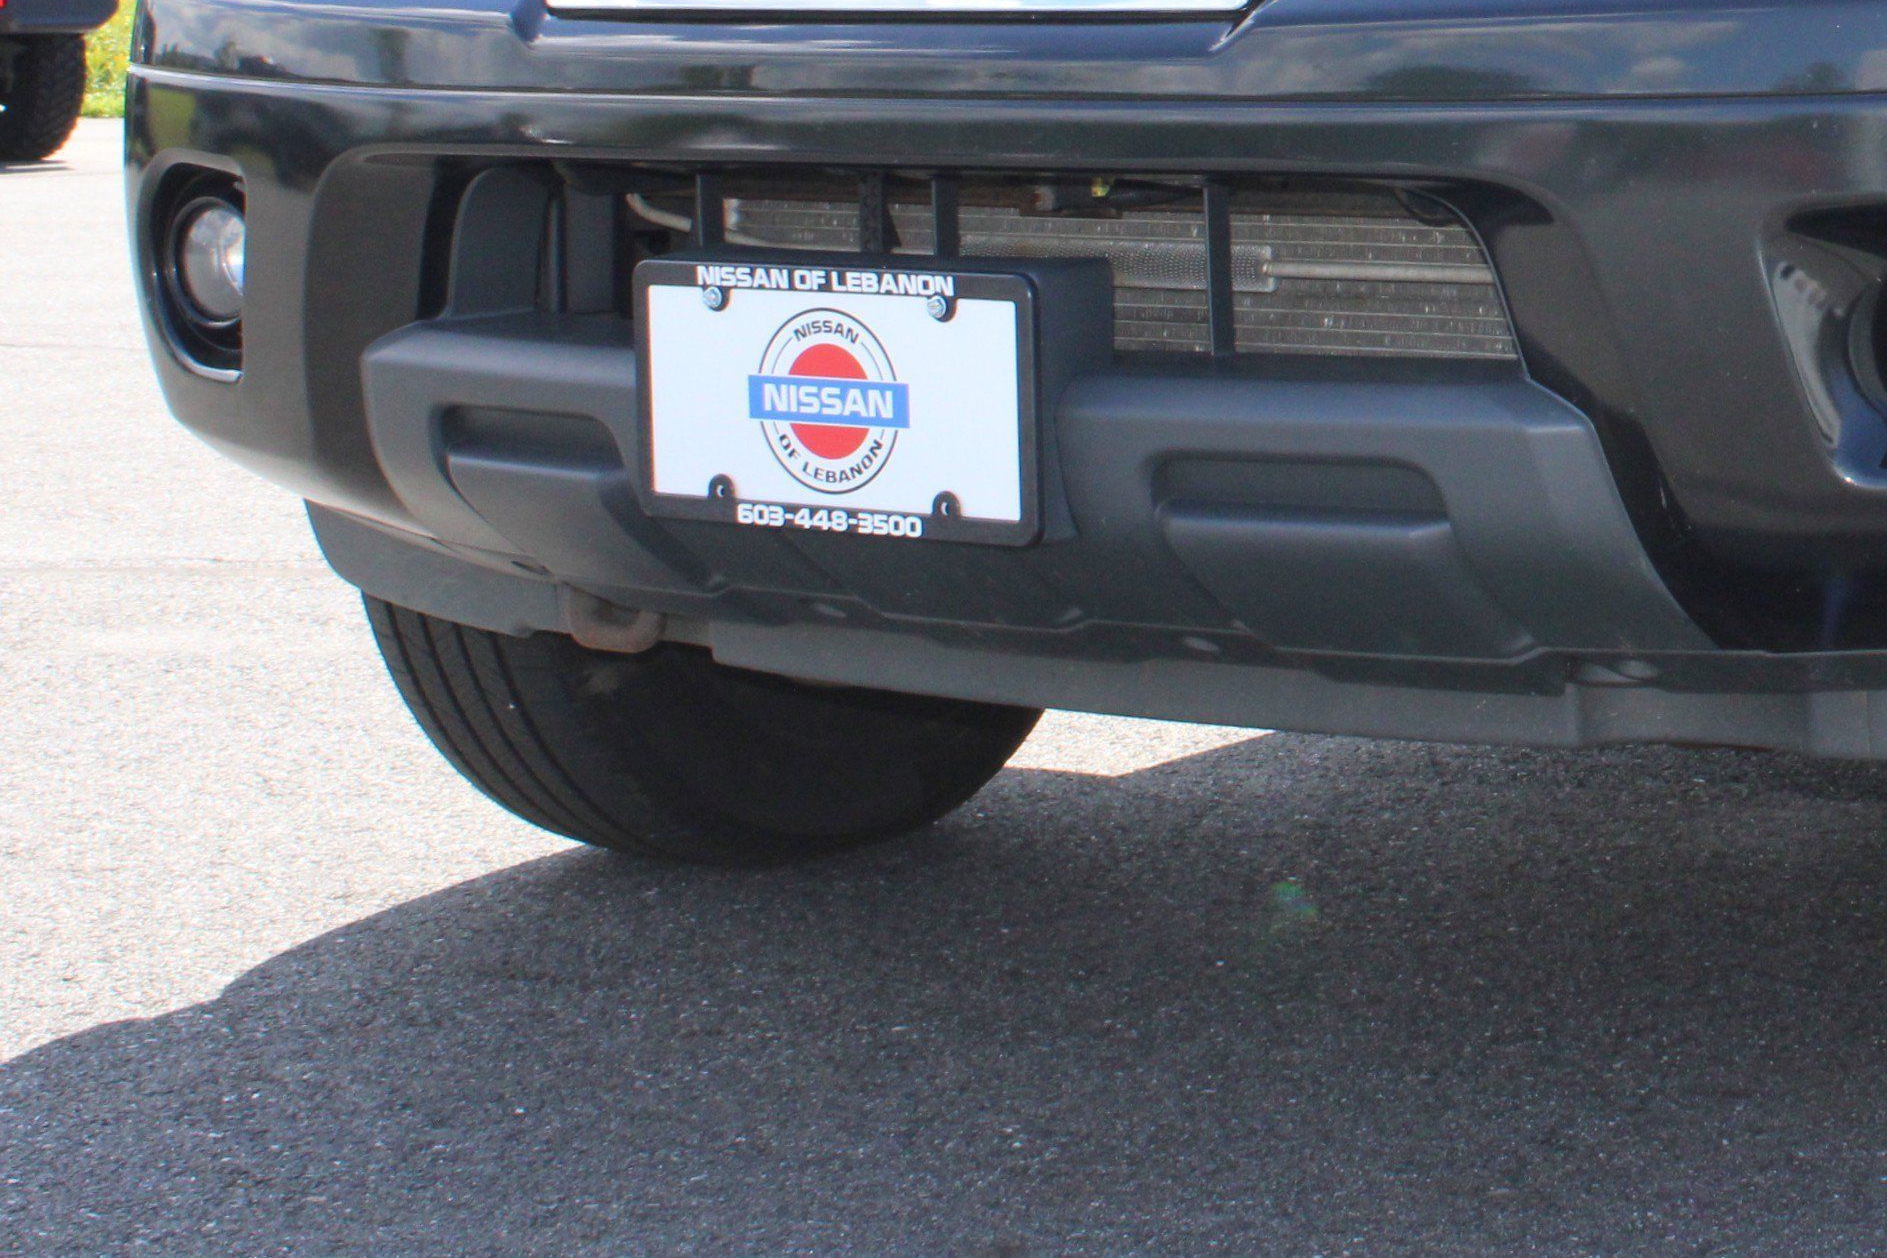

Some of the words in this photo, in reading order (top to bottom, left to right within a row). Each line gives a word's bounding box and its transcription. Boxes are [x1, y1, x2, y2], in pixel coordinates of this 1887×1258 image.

[697, 265, 789, 289] NISSAN
[794, 269, 825, 290] OF
[831, 271, 954, 296] LEBANON
[794, 320, 859, 344] NISSAN
[763, 383, 894, 419] NISSAN
[779, 433, 801, 460] OF
[802, 439, 883, 483] LEBANON
[738, 503, 922, 538] 603-448-3500
